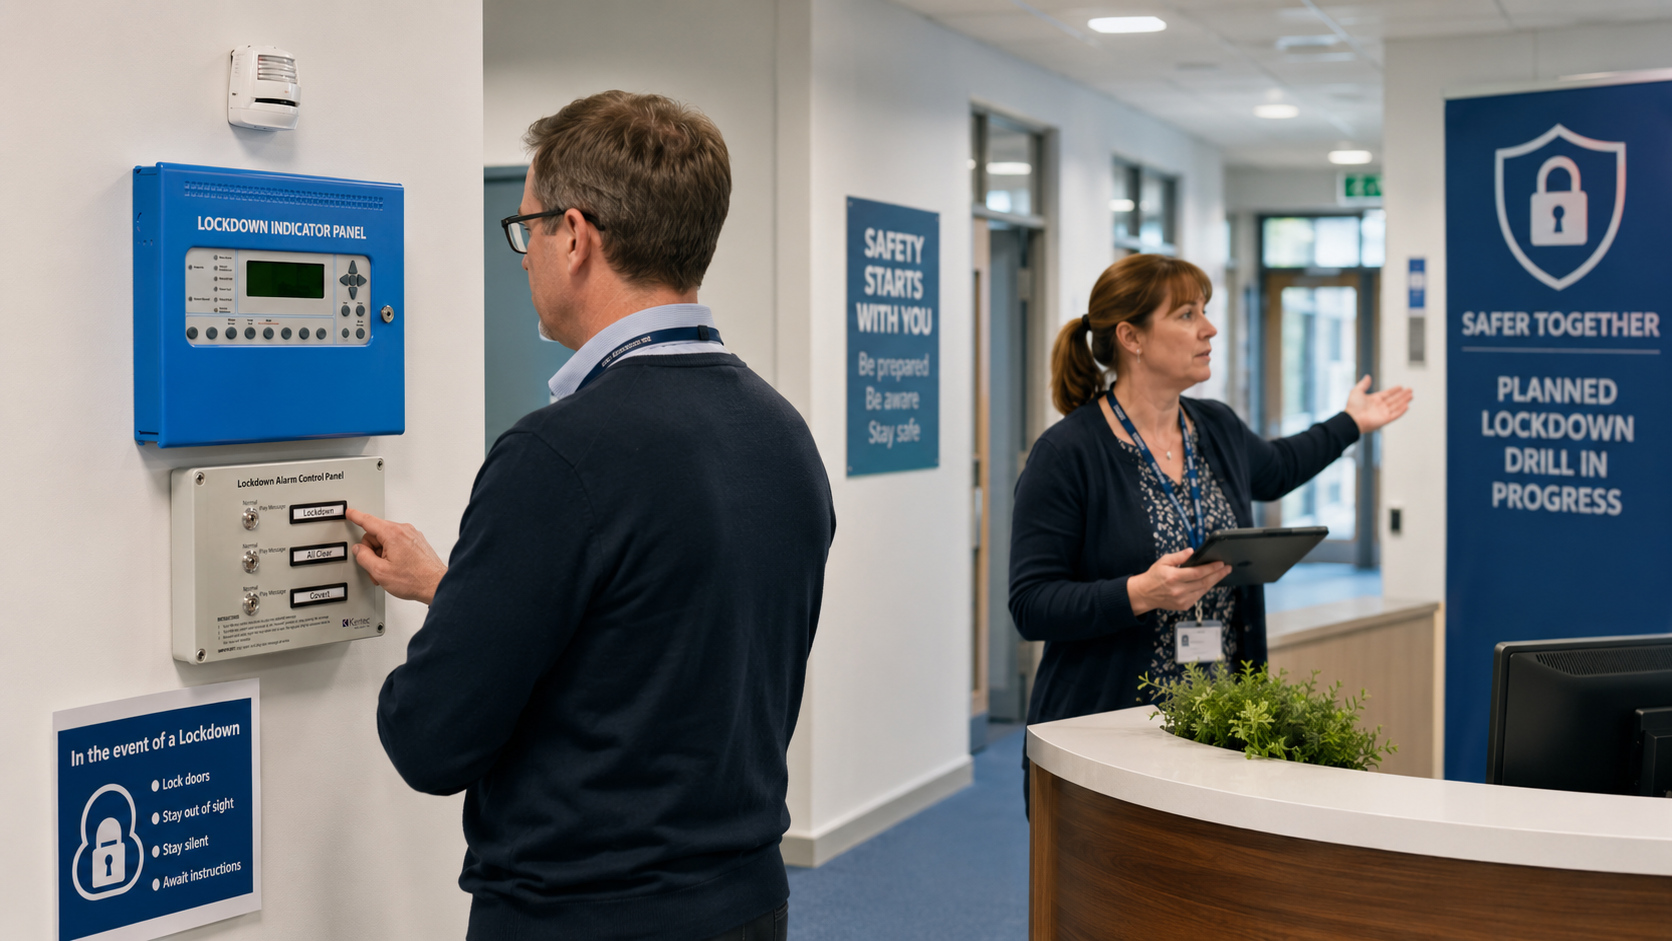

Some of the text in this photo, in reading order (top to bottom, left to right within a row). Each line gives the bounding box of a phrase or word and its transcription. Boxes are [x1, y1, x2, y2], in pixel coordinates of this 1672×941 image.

[197, 215, 367, 240] LOCKDOWN INDICATOR PANEL
[864, 227, 925, 265] SAFETY
[864, 265, 924, 300] STARTS
[856, 302, 932, 336] WITH YOU
[1462, 311, 1661, 337] SAFER TOGETHER
[858, 351, 930, 382] Be prepared
[866, 386, 920, 410] Be aware
[1497, 376, 1618, 405] PLANNED
[868, 417, 921, 449] Stay safe
[1481, 409, 1634, 442] LOCKDOWN
[1505, 446, 1608, 478] DRILL IN
[237, 471, 344, 488] Lockdown Alarm Control Panel
[303, 508, 334, 517] Lockdown
[1492, 481, 1623, 516] PROGRESS
[306, 550, 333, 559] All Clear
[309, 591, 330, 599] Covert
[71, 723, 240, 767] In the event of a Lockdown
[162, 771, 210, 790] Lock doors
[162, 797, 234, 824] Stay out of sight
[162, 835, 209, 856] Stay silent
[163, 861, 242, 889] Await instructions
